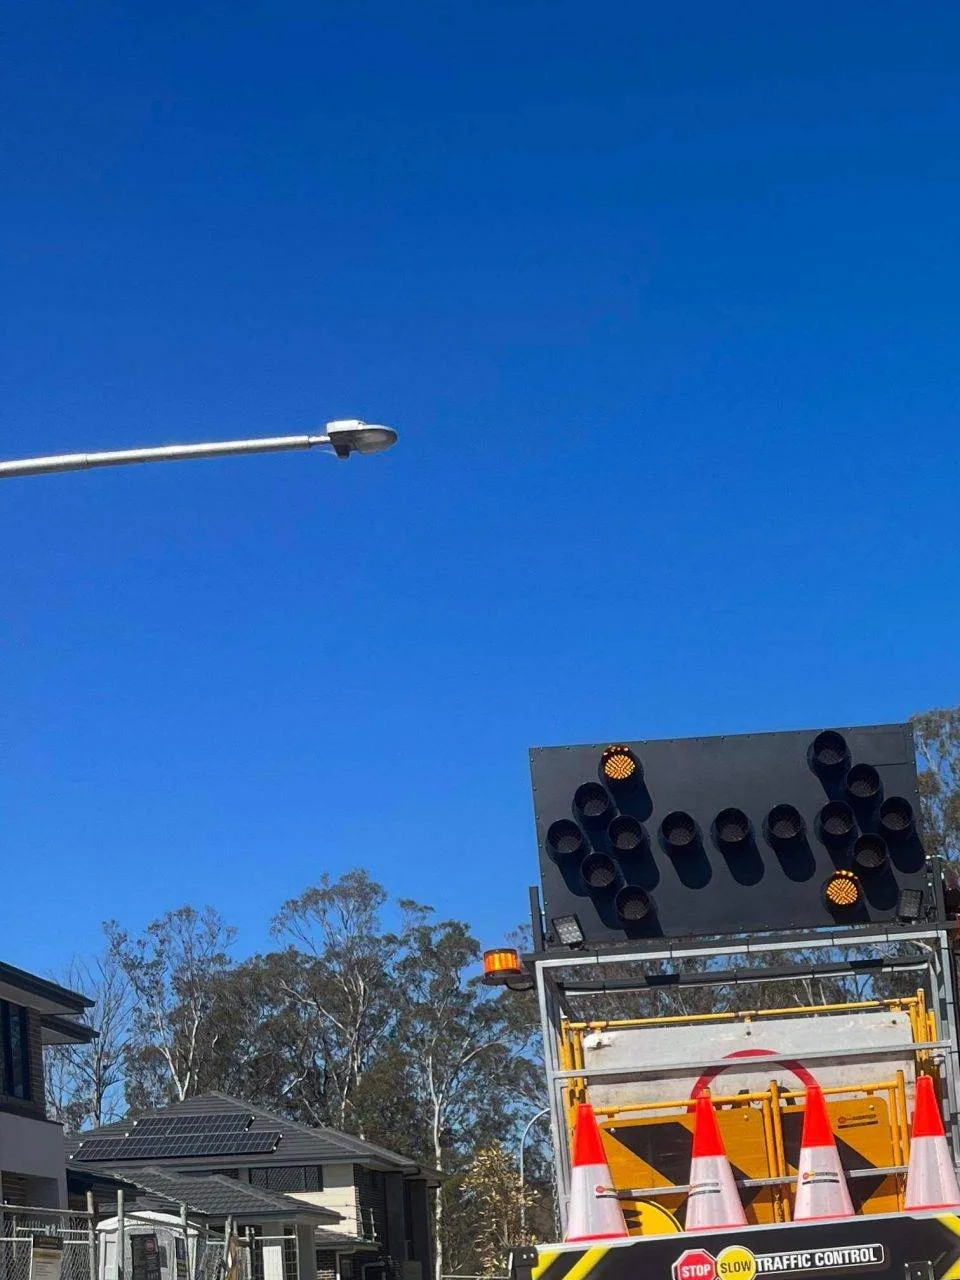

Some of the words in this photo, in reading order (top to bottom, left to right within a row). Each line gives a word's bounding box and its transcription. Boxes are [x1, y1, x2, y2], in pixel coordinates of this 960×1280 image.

[682, 1263, 711, 1278] STOP
[720, 1260, 751, 1274] SLOW
[756, 1254, 811, 1272] TRAFFIC
[814, 1247, 877, 1267] CONTROL
